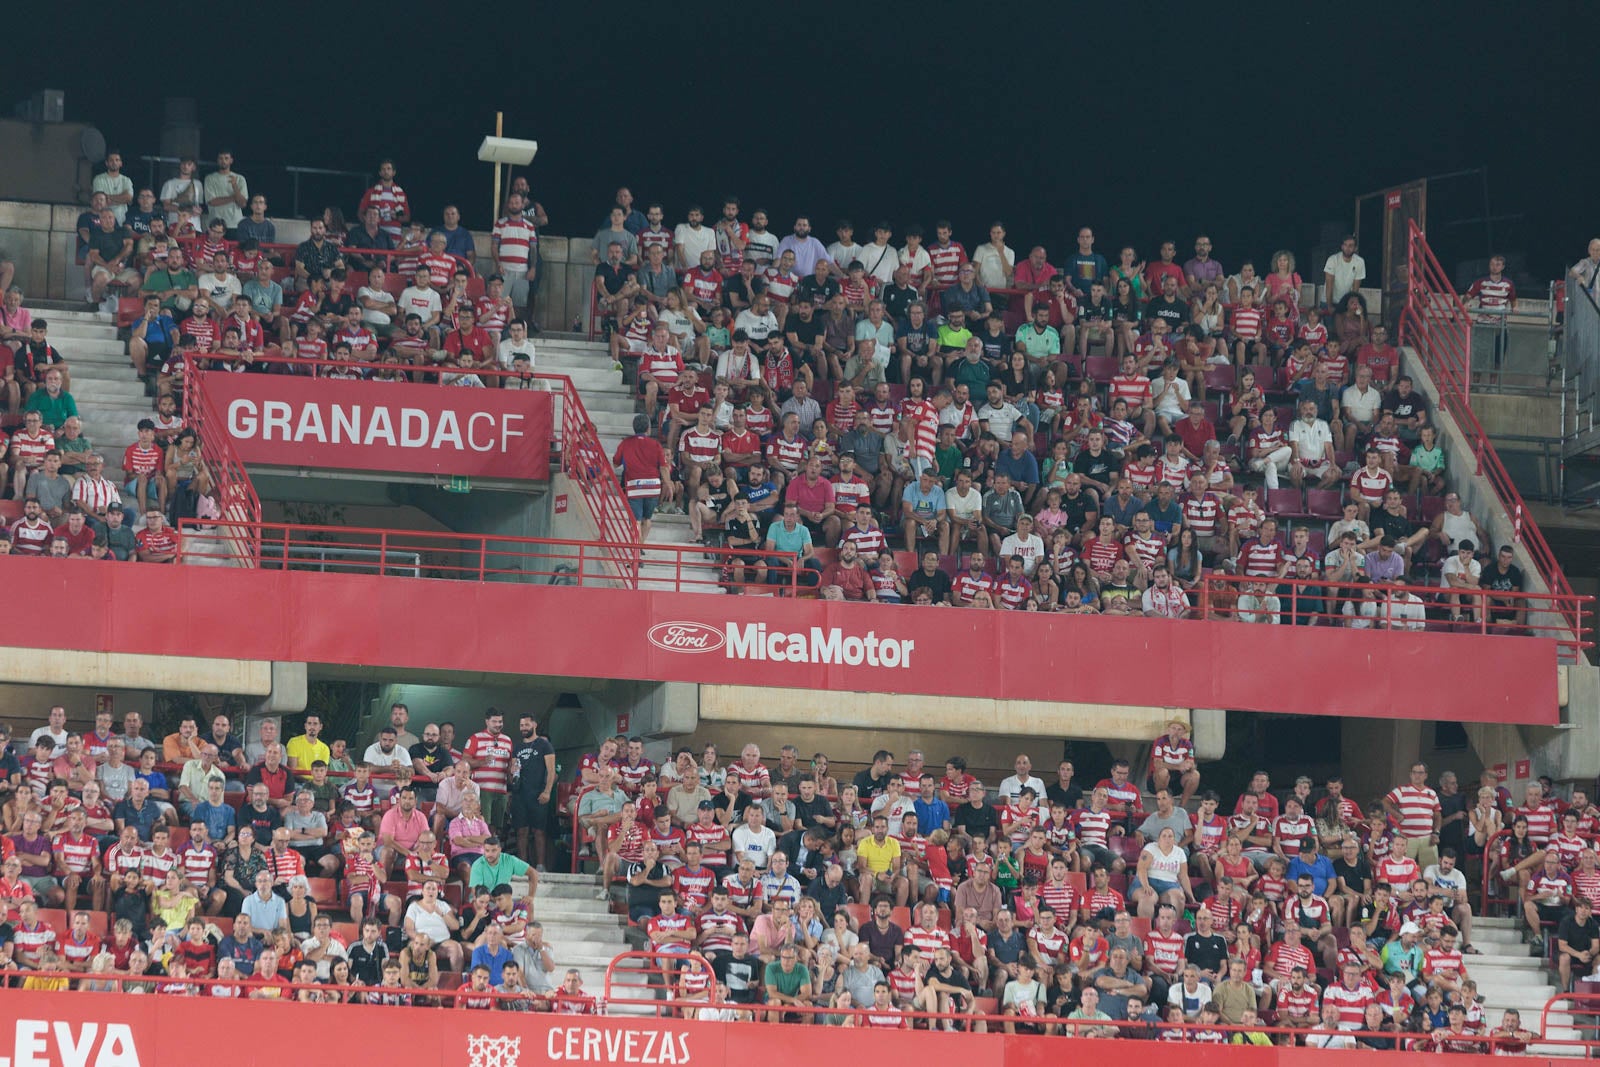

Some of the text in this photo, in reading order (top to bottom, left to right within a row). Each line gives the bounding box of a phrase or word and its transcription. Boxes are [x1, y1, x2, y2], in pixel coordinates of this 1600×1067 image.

[1157, 310, 1180, 319] adidas
[663, 626, 709, 648] Ford
[0, 1019, 141, 1067] EVA
[547, 1027, 691, 1064] CERVEZAS
